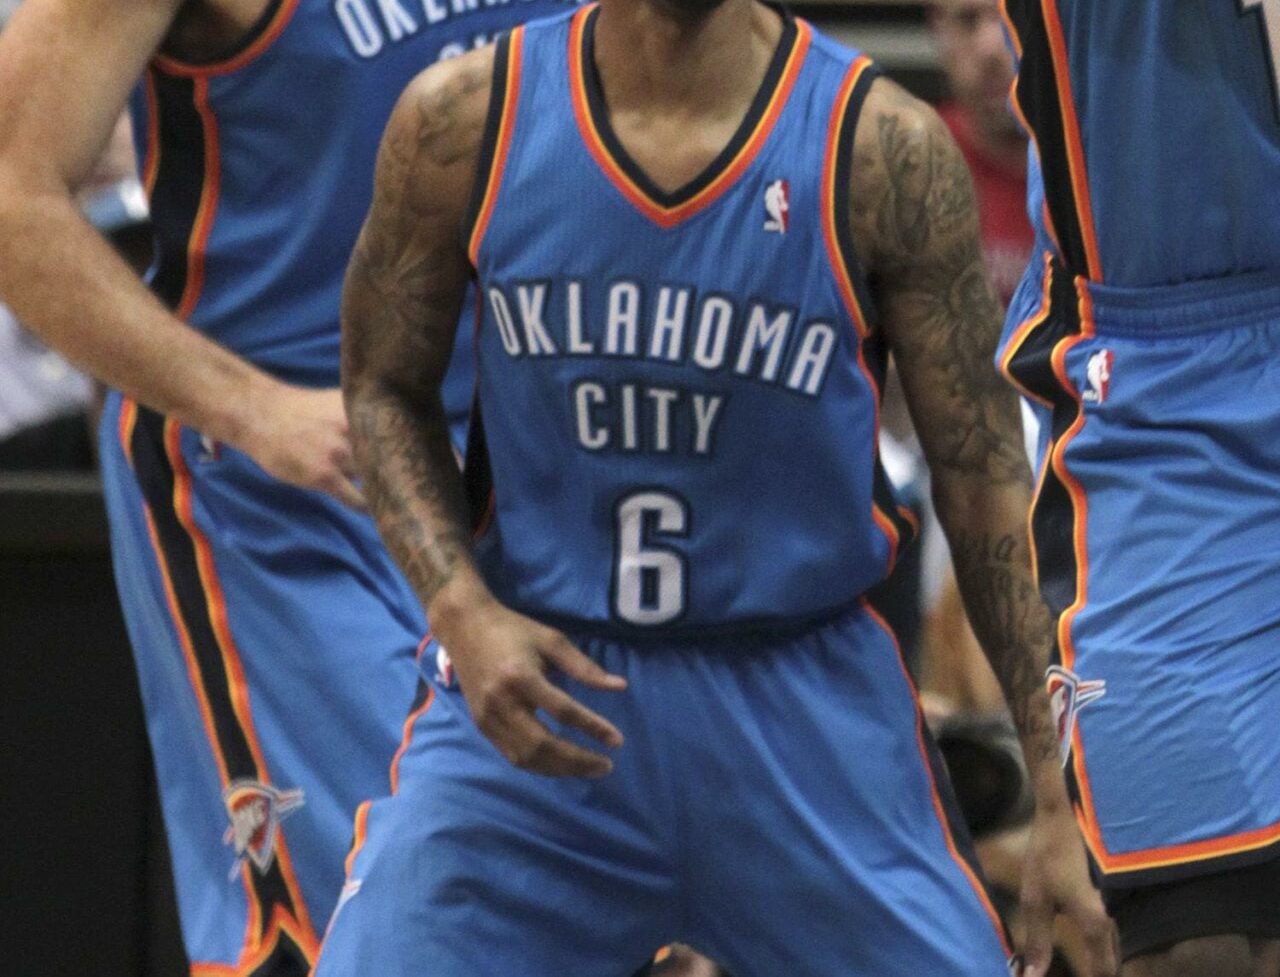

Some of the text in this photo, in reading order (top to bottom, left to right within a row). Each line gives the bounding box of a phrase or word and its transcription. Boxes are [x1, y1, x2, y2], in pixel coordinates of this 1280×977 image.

[488, 281, 836, 396] OKLAHOMA
[574, 381, 723, 453] CITY
[614, 490, 687, 627] 6
